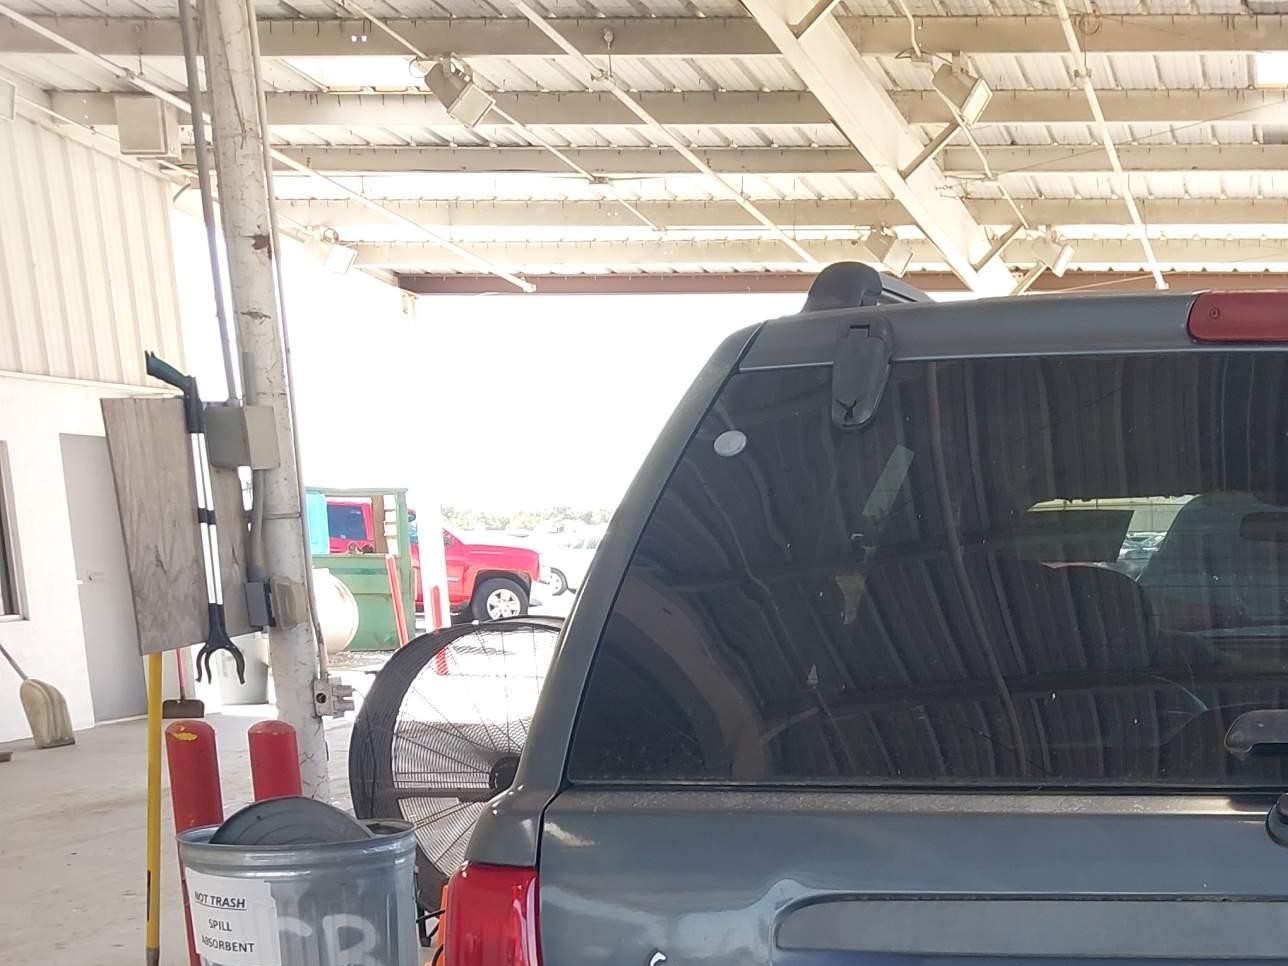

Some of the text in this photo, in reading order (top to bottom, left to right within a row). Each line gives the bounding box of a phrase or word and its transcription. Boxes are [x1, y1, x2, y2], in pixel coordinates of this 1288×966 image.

[194, 890, 246, 908] NOT TRASH
[208, 918, 233, 932] SPILL
[201, 935, 256, 953] ABSORBENT
